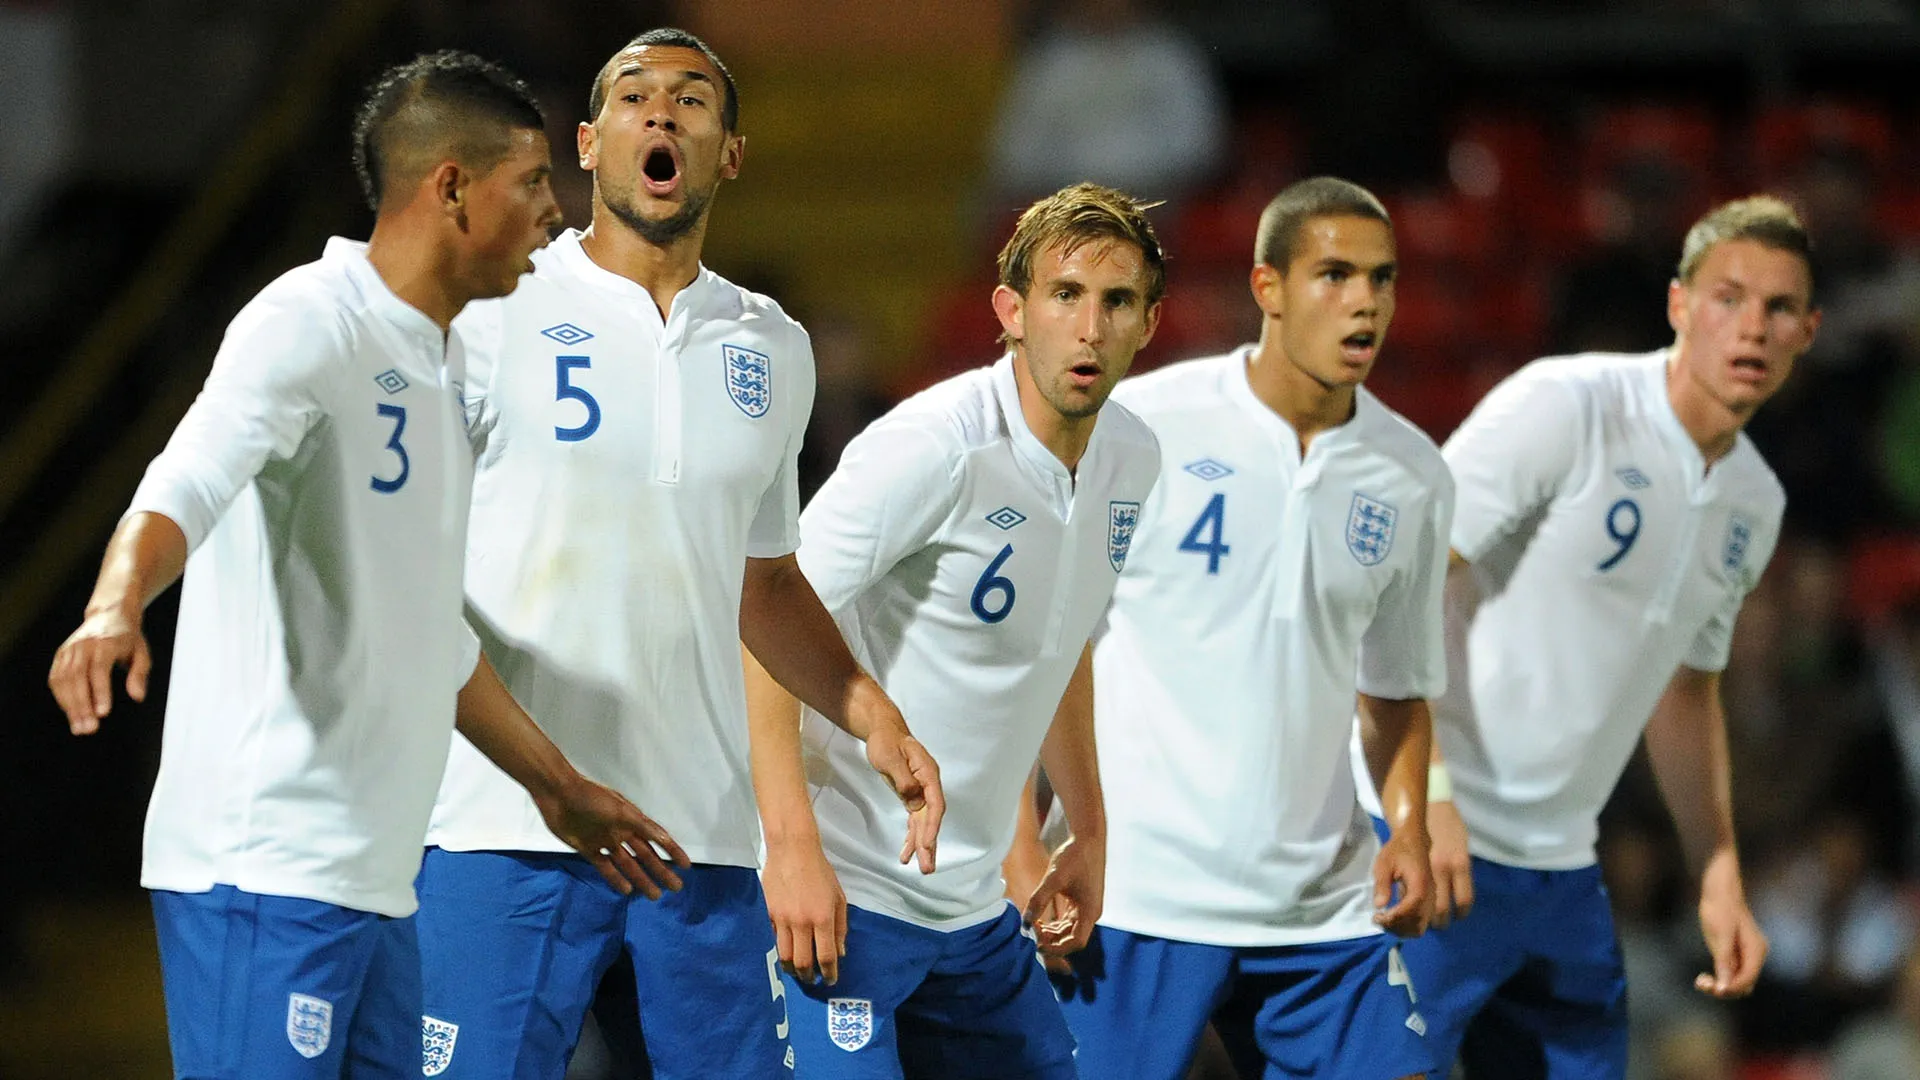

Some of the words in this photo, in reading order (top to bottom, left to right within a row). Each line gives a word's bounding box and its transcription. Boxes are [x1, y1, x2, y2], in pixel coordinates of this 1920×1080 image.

[554, 354, 602, 443] 5
[370, 403, 410, 494] 3
[1177, 492, 1232, 576] 4
[1597, 497, 1643, 571] 9
[970, 543, 1015, 624] 6
